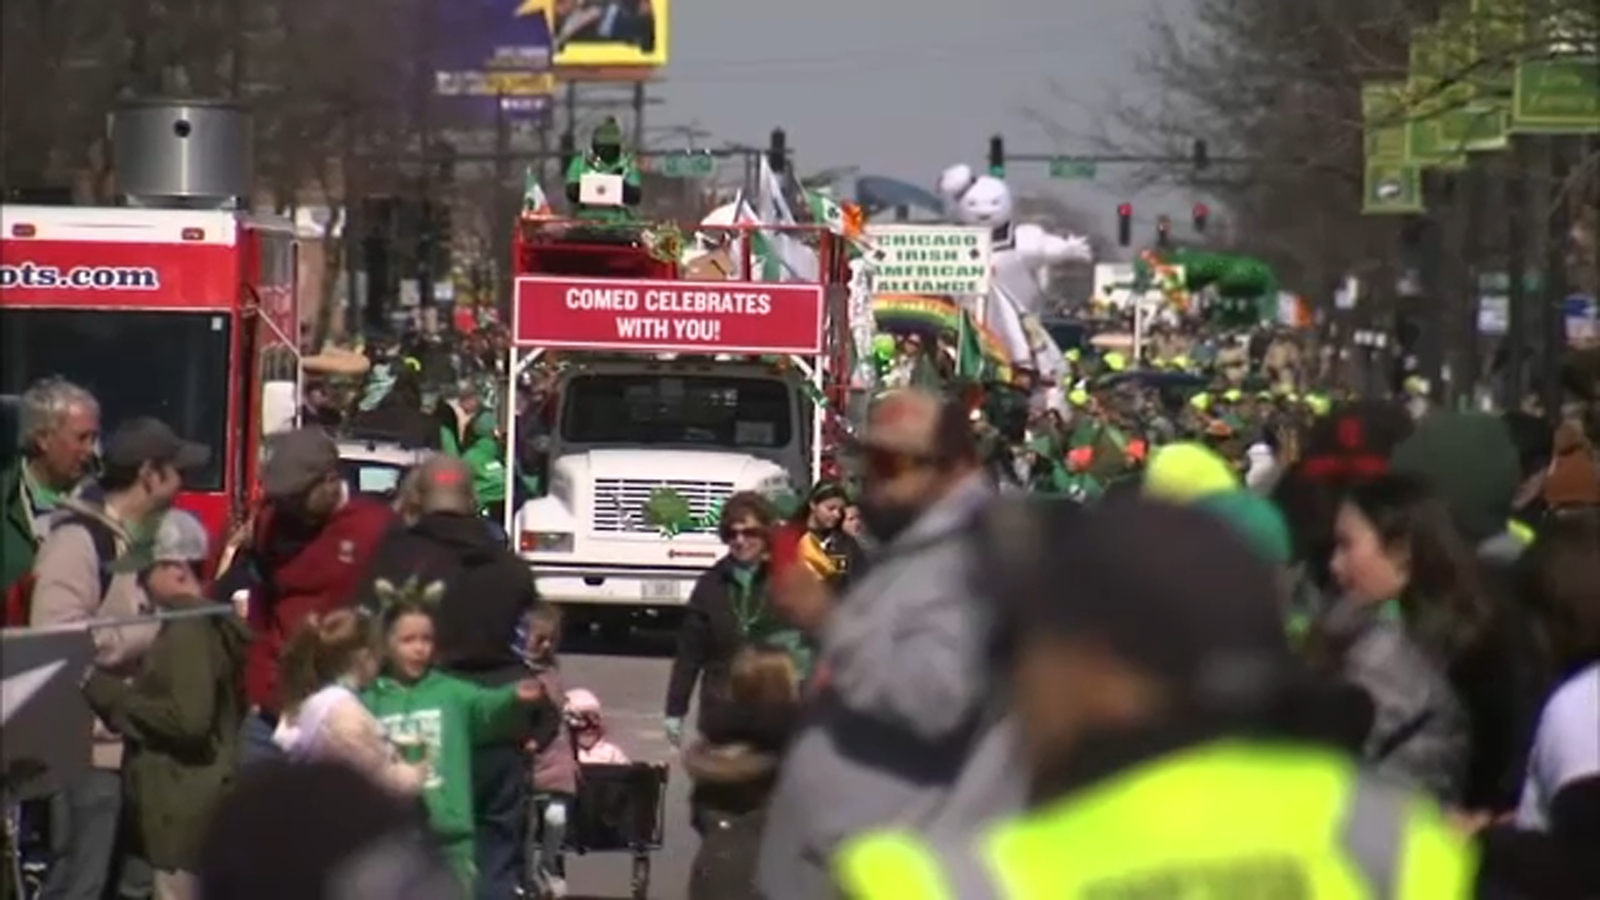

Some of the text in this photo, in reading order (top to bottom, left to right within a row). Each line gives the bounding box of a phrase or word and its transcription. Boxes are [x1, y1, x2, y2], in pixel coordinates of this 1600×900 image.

[877, 234, 978, 247] CHICAGO
[896, 250, 958, 261] IRISH
[1, 262, 157, 288] ots.com
[874, 264, 985, 277] AMERICAN
[877, 281, 978, 292] ALLIANCE
[566, 288, 771, 314] COMED CELEBRATES
[616, 317, 721, 341] WITH YOU!
